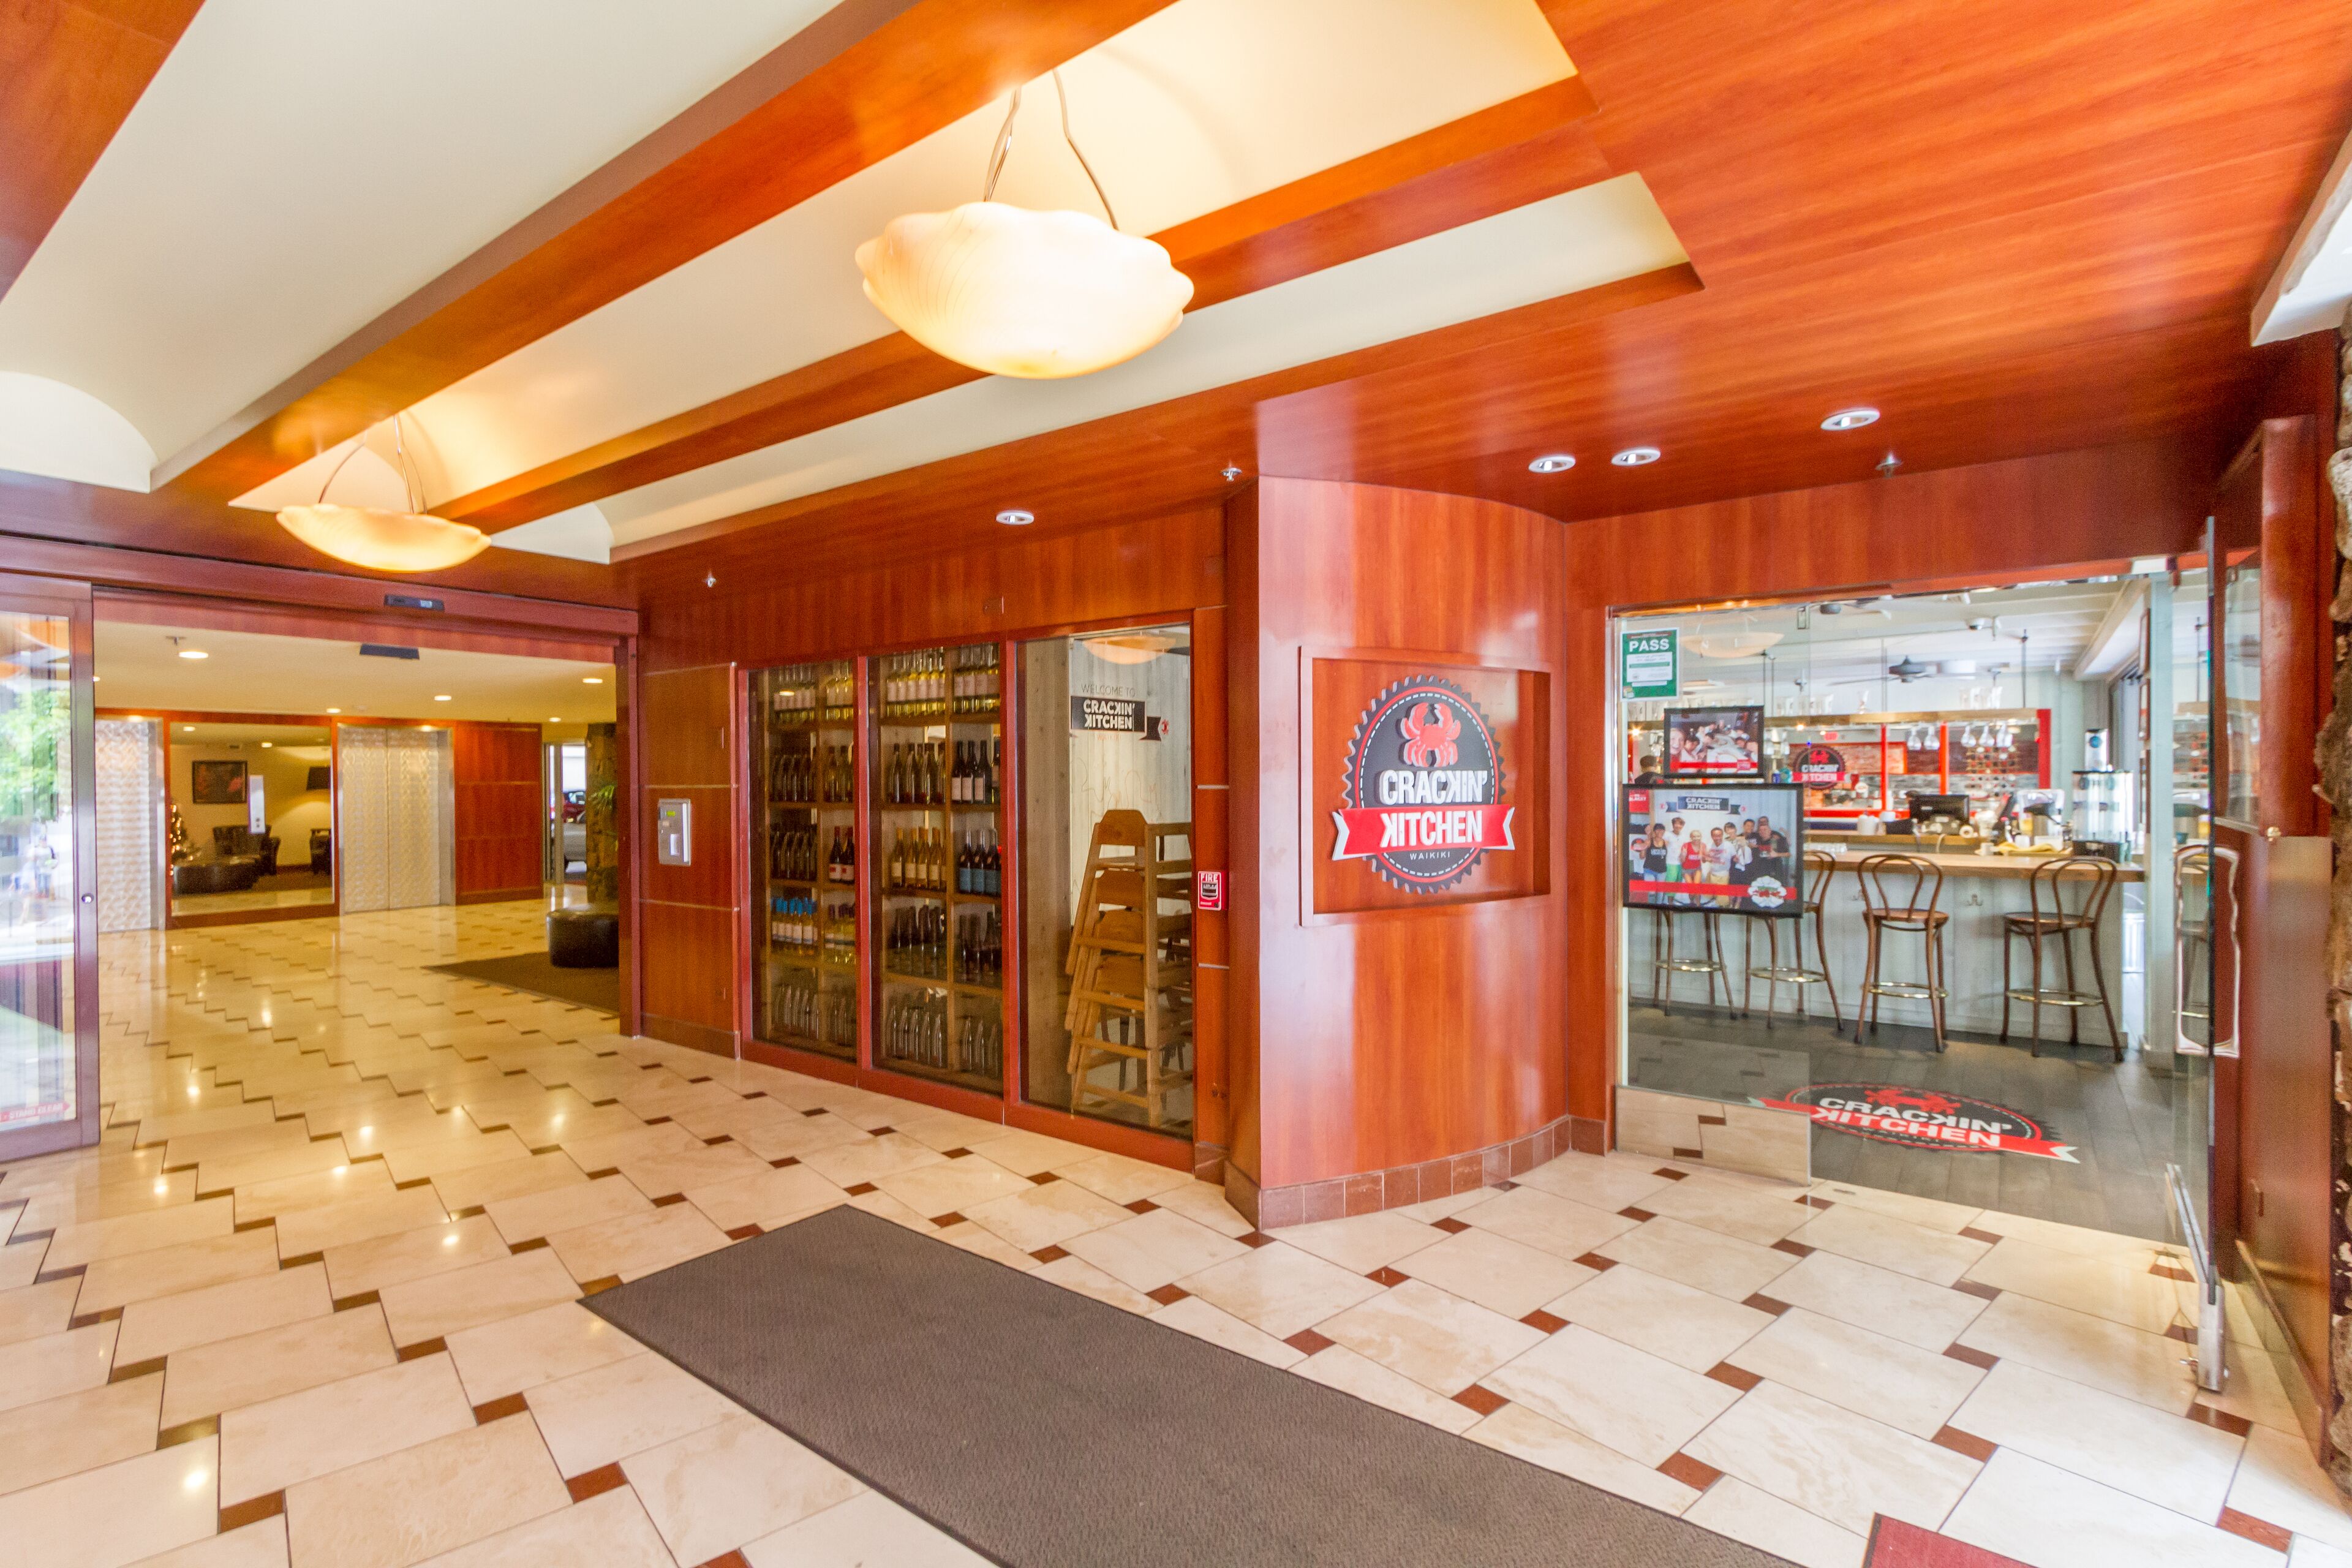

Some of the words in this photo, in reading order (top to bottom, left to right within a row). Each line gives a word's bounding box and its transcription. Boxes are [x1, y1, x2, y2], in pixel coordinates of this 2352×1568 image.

[1629, 638, 1670, 652] PASS
[1081, 684, 1123, 697] WELCOME
[1126, 687, 1136, 698] TO
[1083, 698, 1135, 715] CRACKIN'
[1084, 714, 1133, 729] KITCHEN
[1379, 769, 1488, 805] CRACKIN'
[1380, 810, 1483, 848] KITCHEN
[1409, 851, 1451, 861] WAIKIKI
[1200, 873, 1218, 882] FIRE
[1819, 1098, 2012, 1134] CRACKIN'
[1811, 1107, 2000, 1147] KITCHEN
